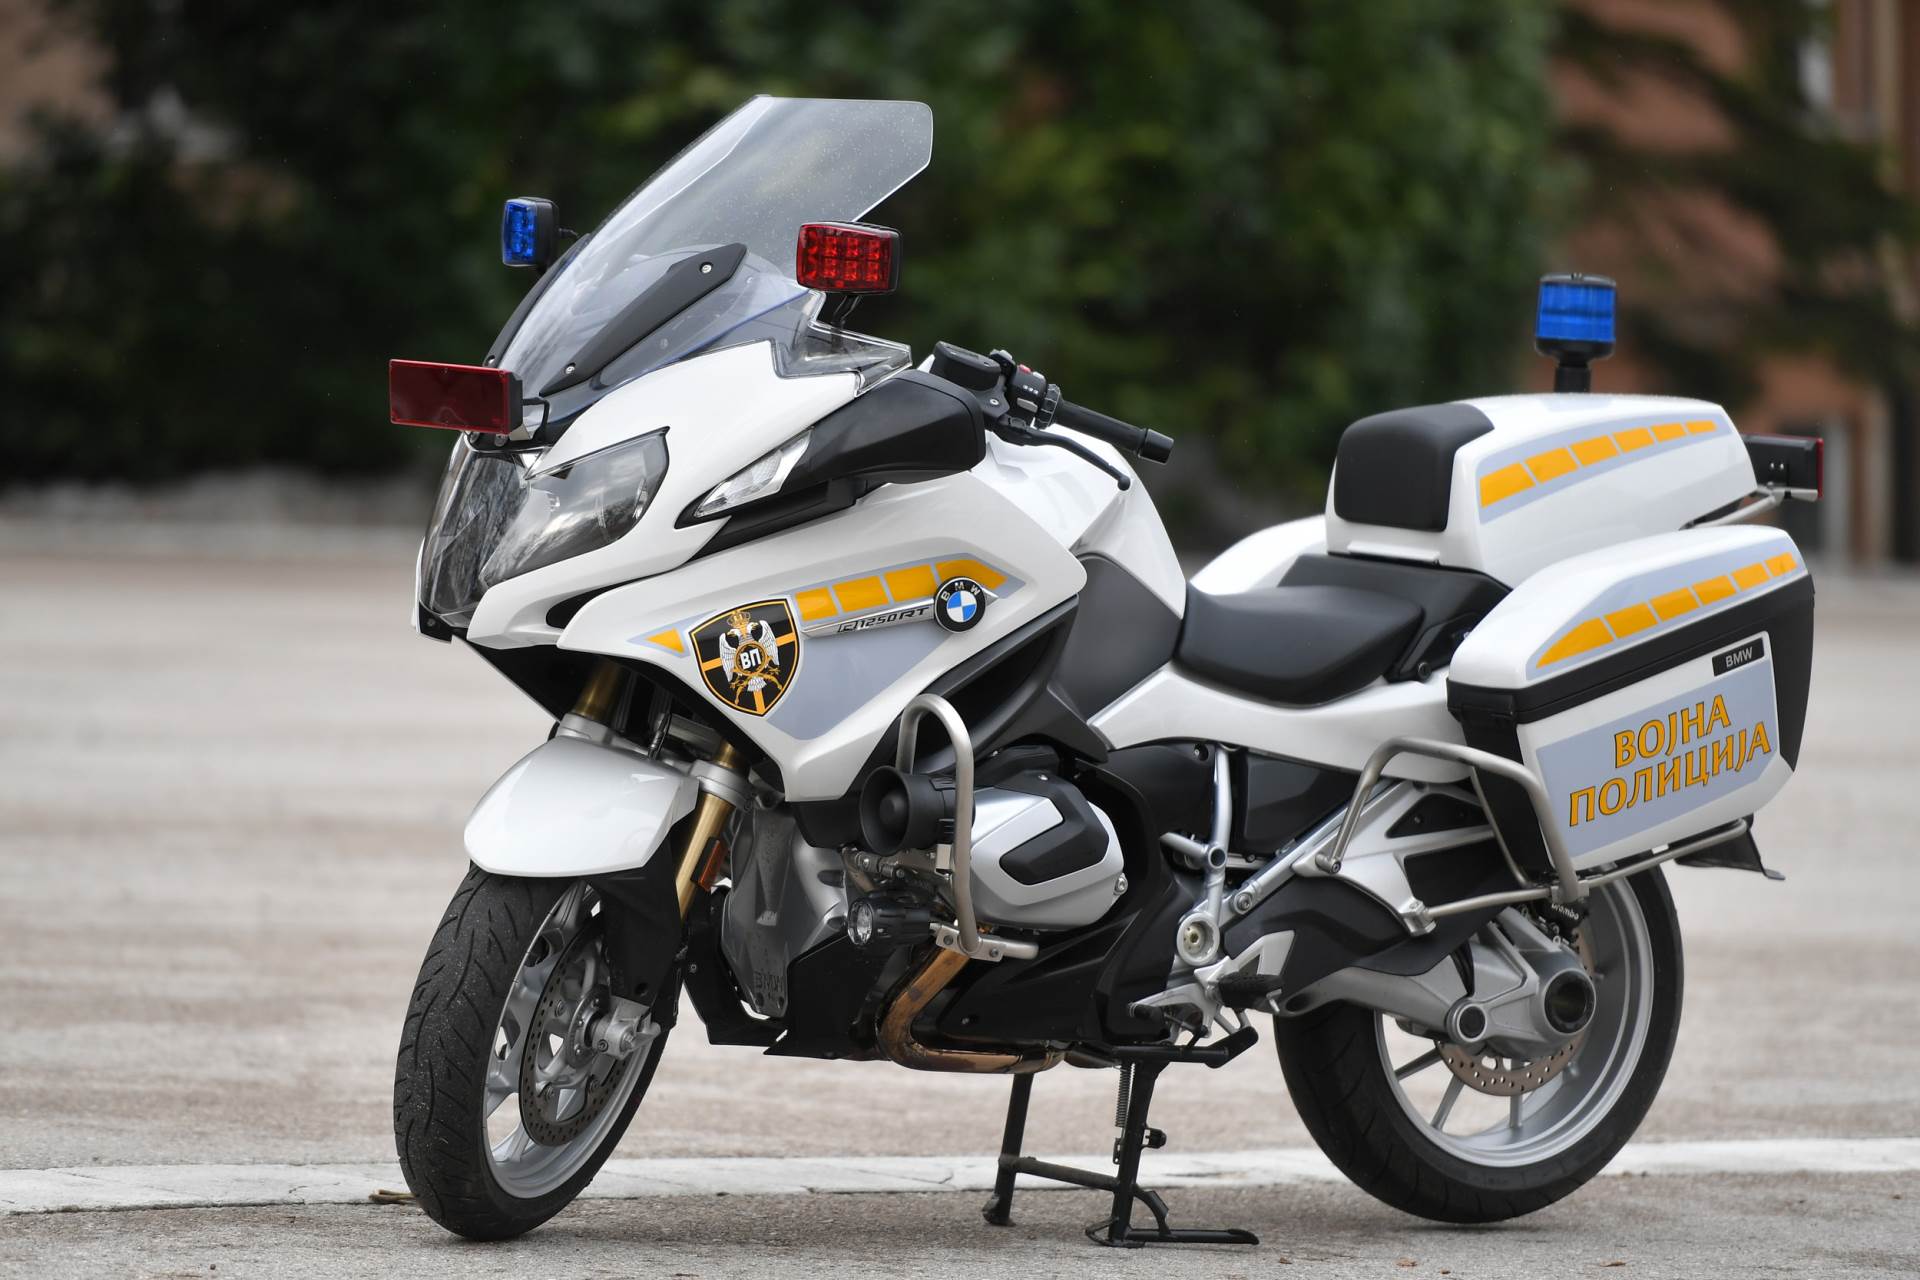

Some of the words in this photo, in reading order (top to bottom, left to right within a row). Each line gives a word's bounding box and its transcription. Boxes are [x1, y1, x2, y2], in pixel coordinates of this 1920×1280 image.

[941, 581, 981, 601] BMW
[740, 648, 762, 670] ВП
[1725, 646, 1753, 669] BMW
[1614, 693, 1732, 769] ВОЈНА
[1569, 720, 1772, 828] ПОЛИЦИЈА
